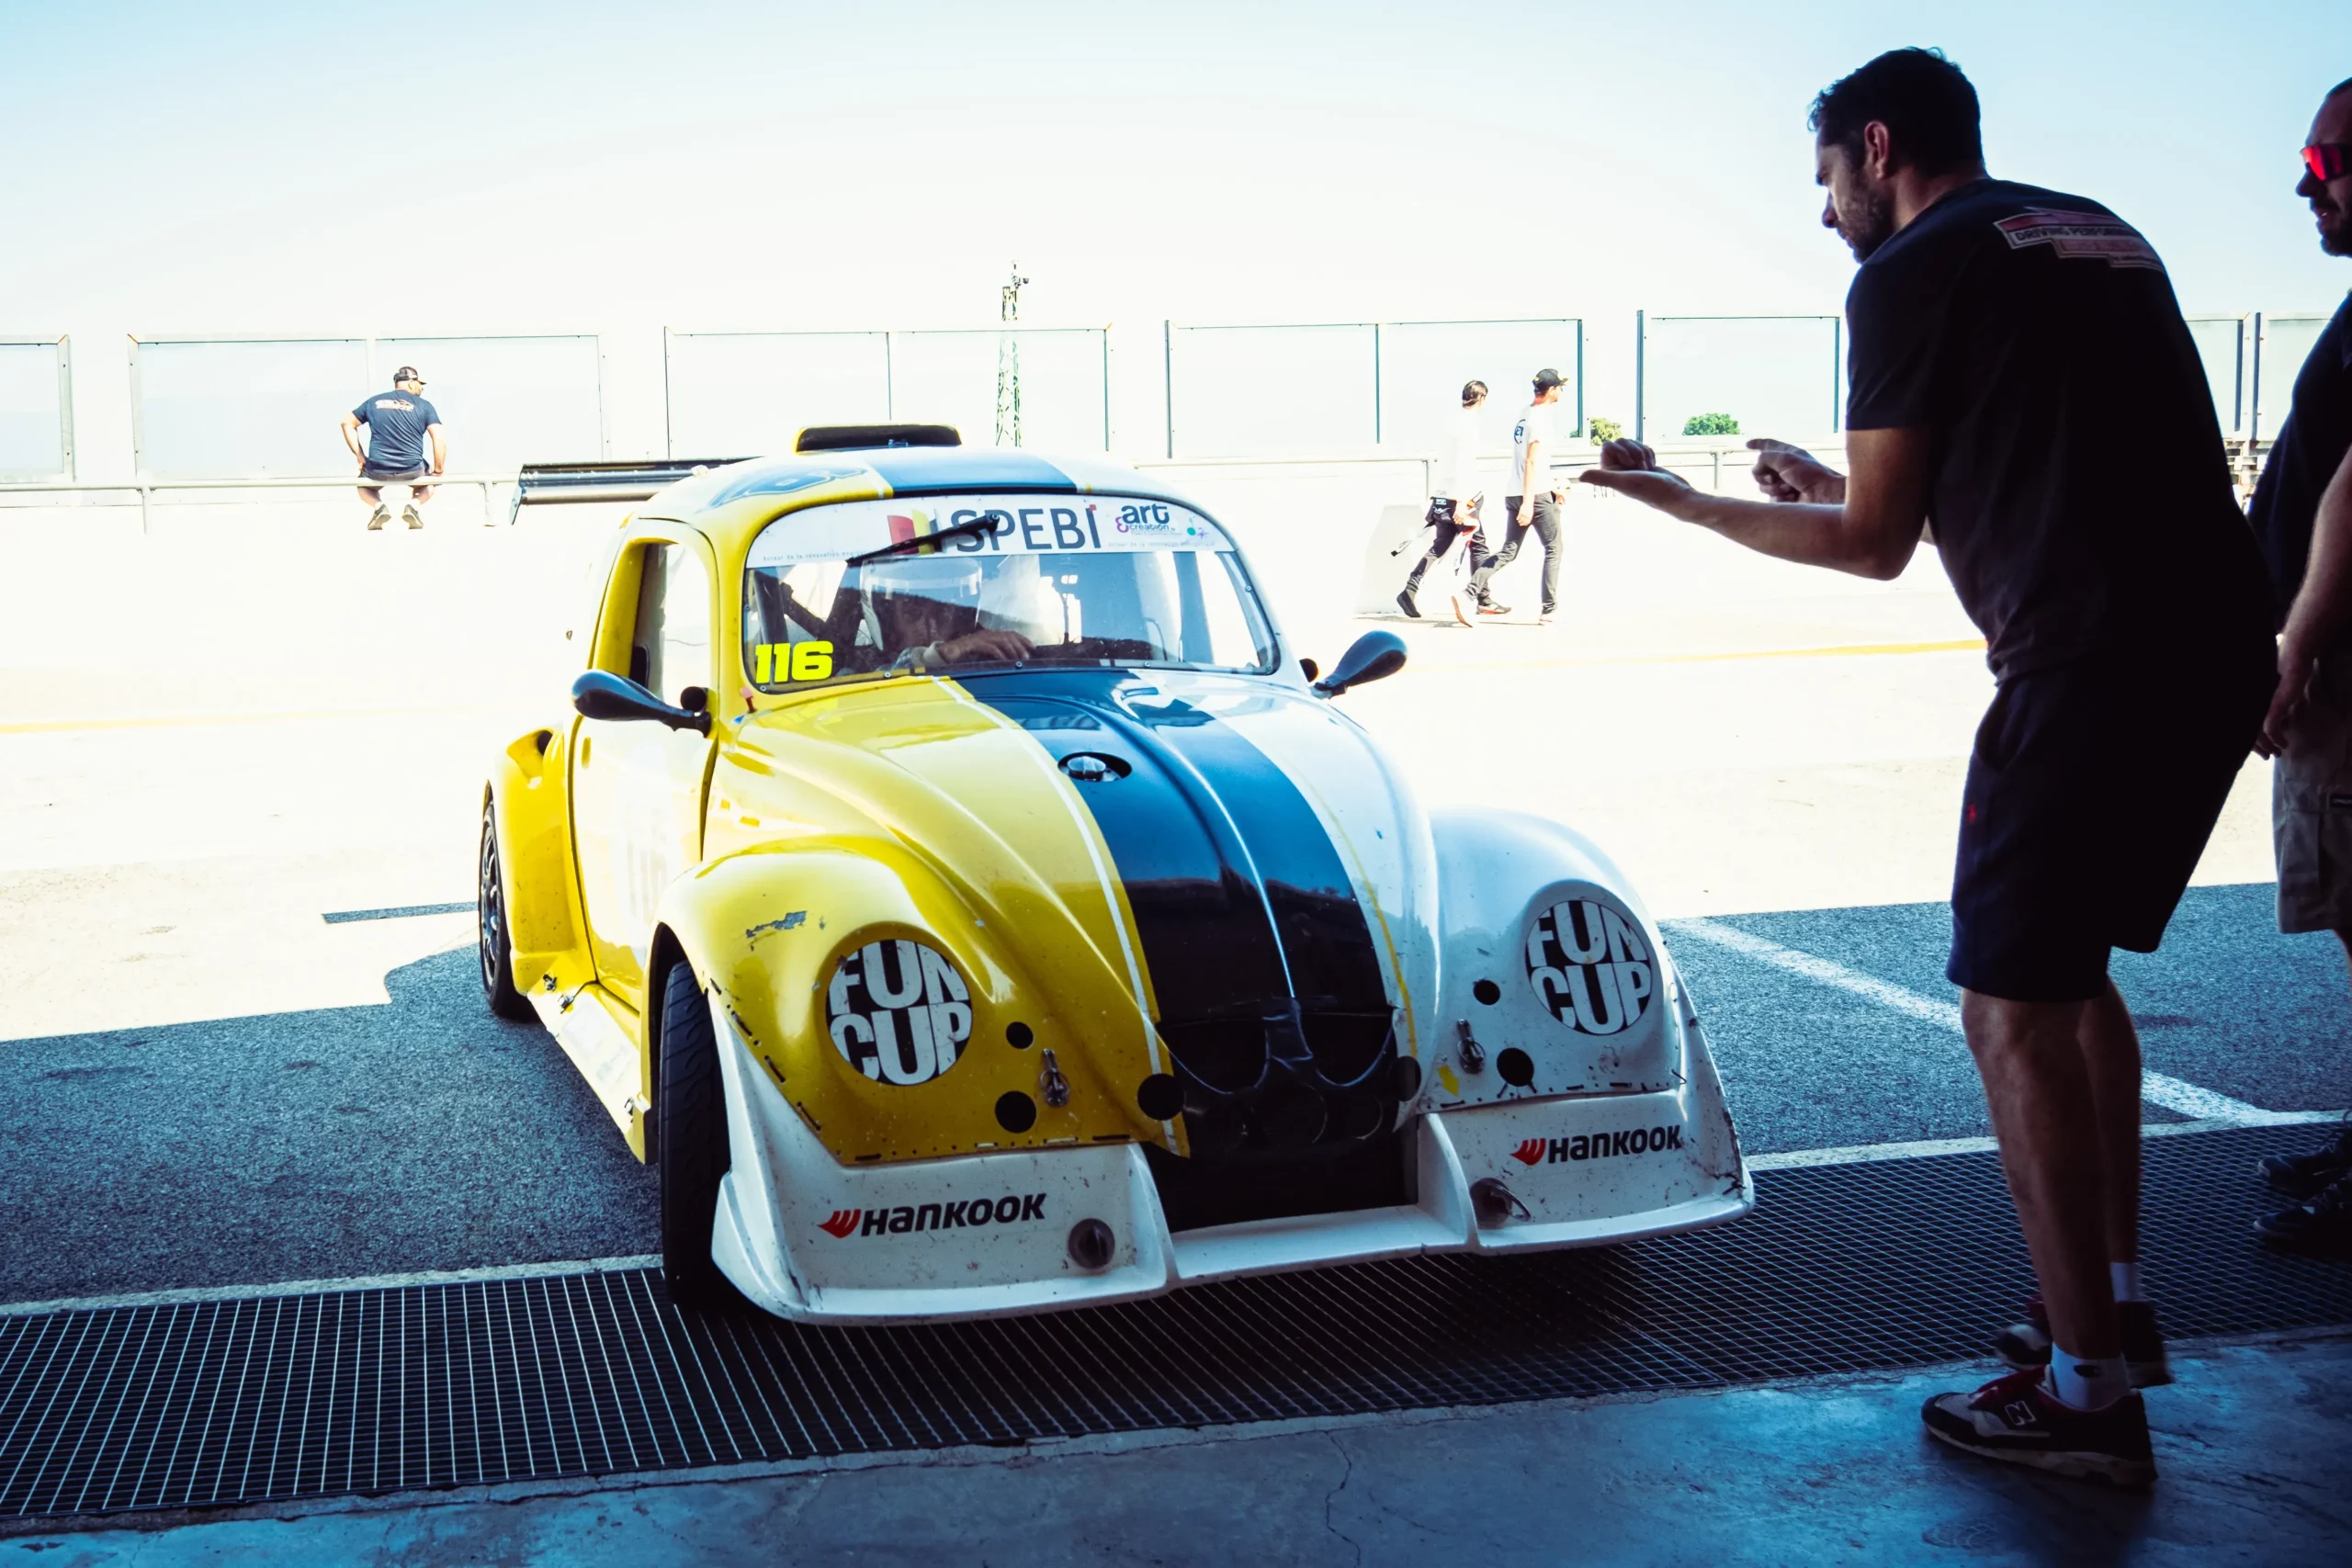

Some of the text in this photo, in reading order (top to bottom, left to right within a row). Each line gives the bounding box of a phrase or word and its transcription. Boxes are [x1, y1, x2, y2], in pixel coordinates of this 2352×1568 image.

[1121, 503, 1170, 525] art
[755, 640, 833, 683] 116
[1527, 900, 1648, 967] FUN
[829, 939, 969, 1015] FUN
[1531, 961, 1651, 1034] CUP
[830, 1001, 972, 1085] CUP
